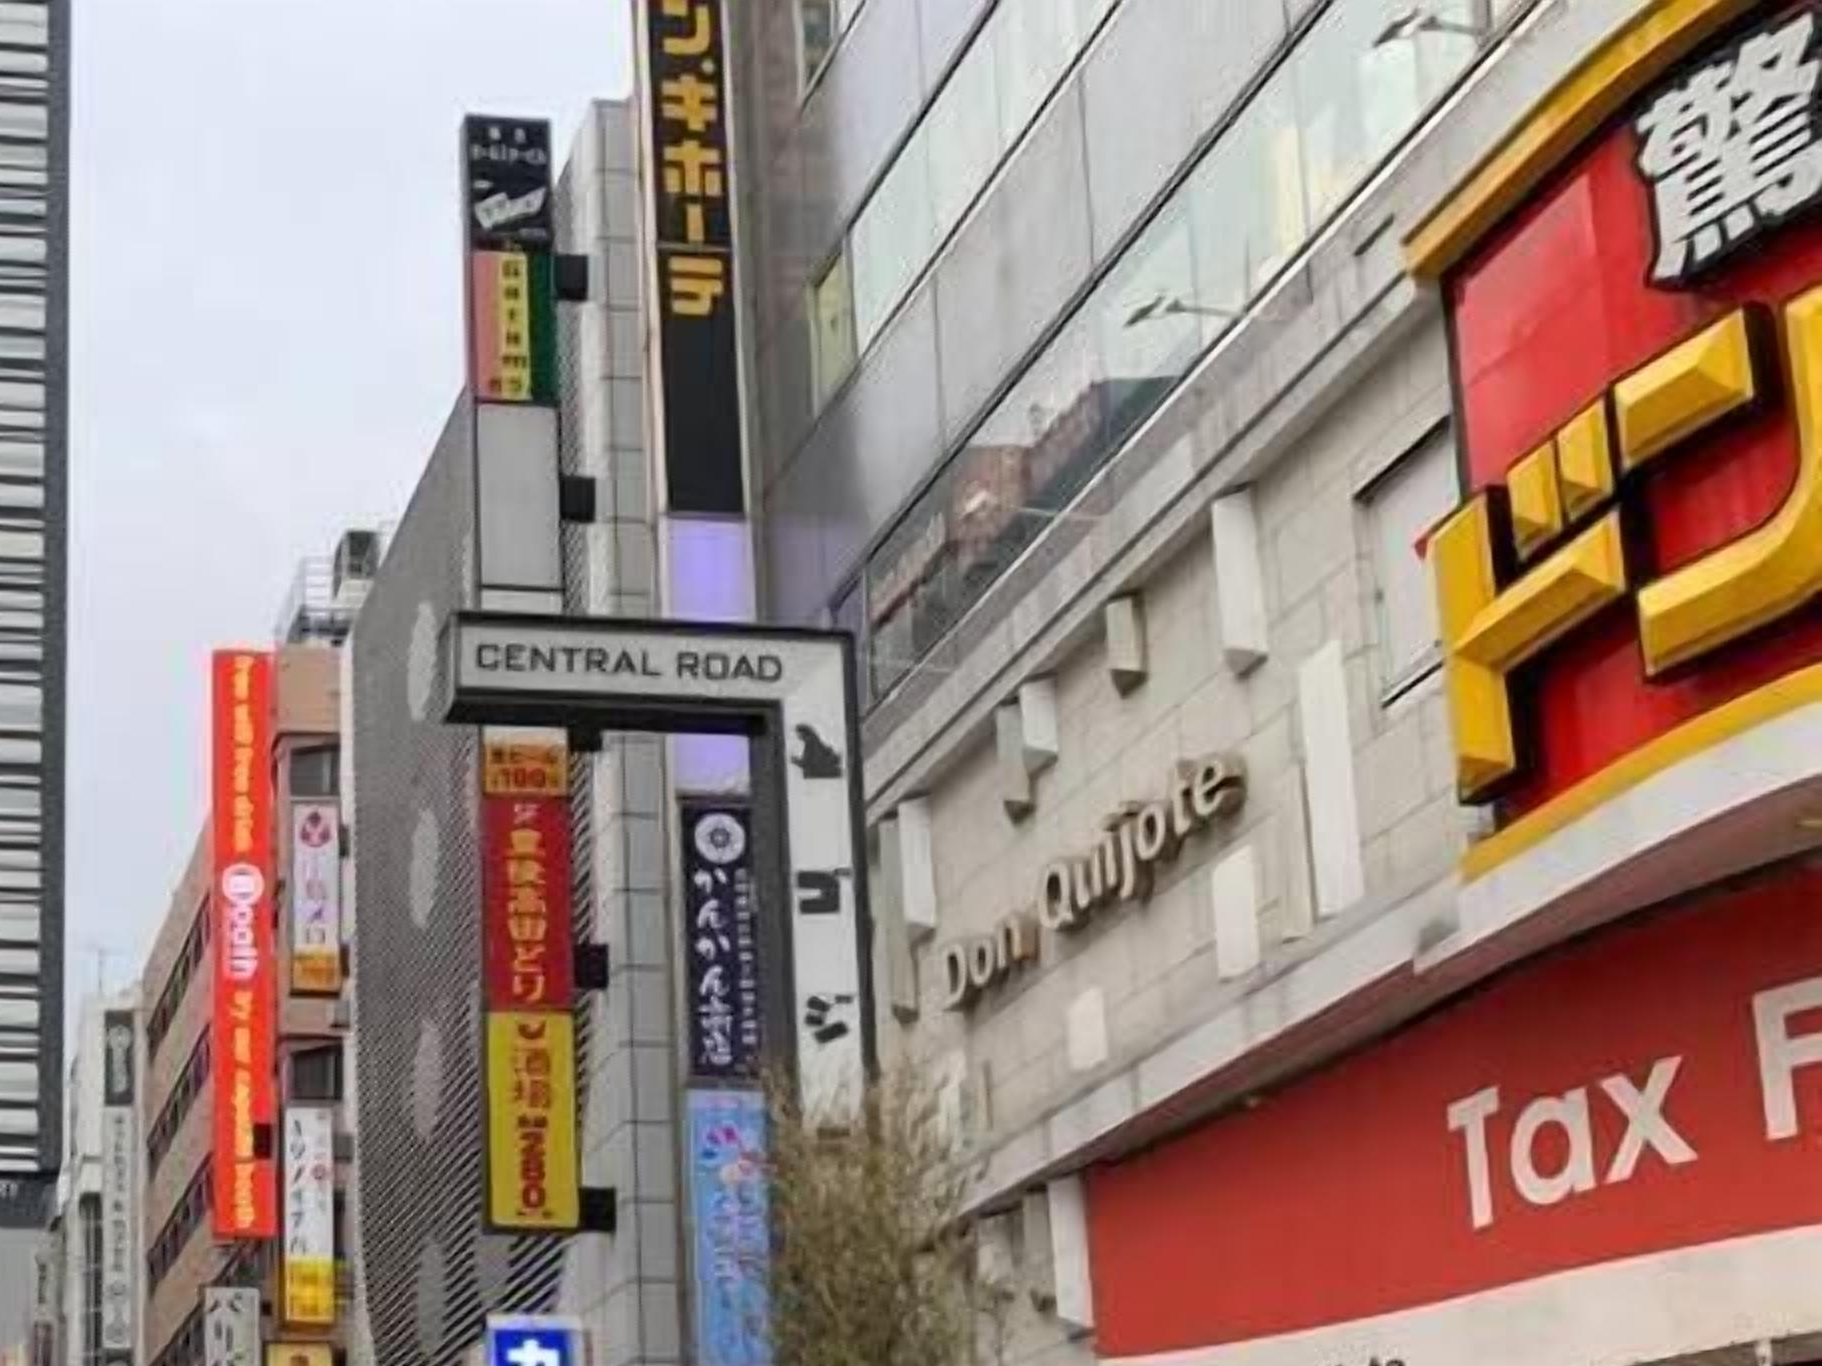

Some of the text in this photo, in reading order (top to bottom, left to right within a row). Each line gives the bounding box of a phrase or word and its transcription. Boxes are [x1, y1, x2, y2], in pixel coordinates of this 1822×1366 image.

[476, 643, 784, 684] CENTRAL ROAD
[938, 748, 1247, 1008] Don Quijote
[1446, 1056, 1697, 1231] Tax
